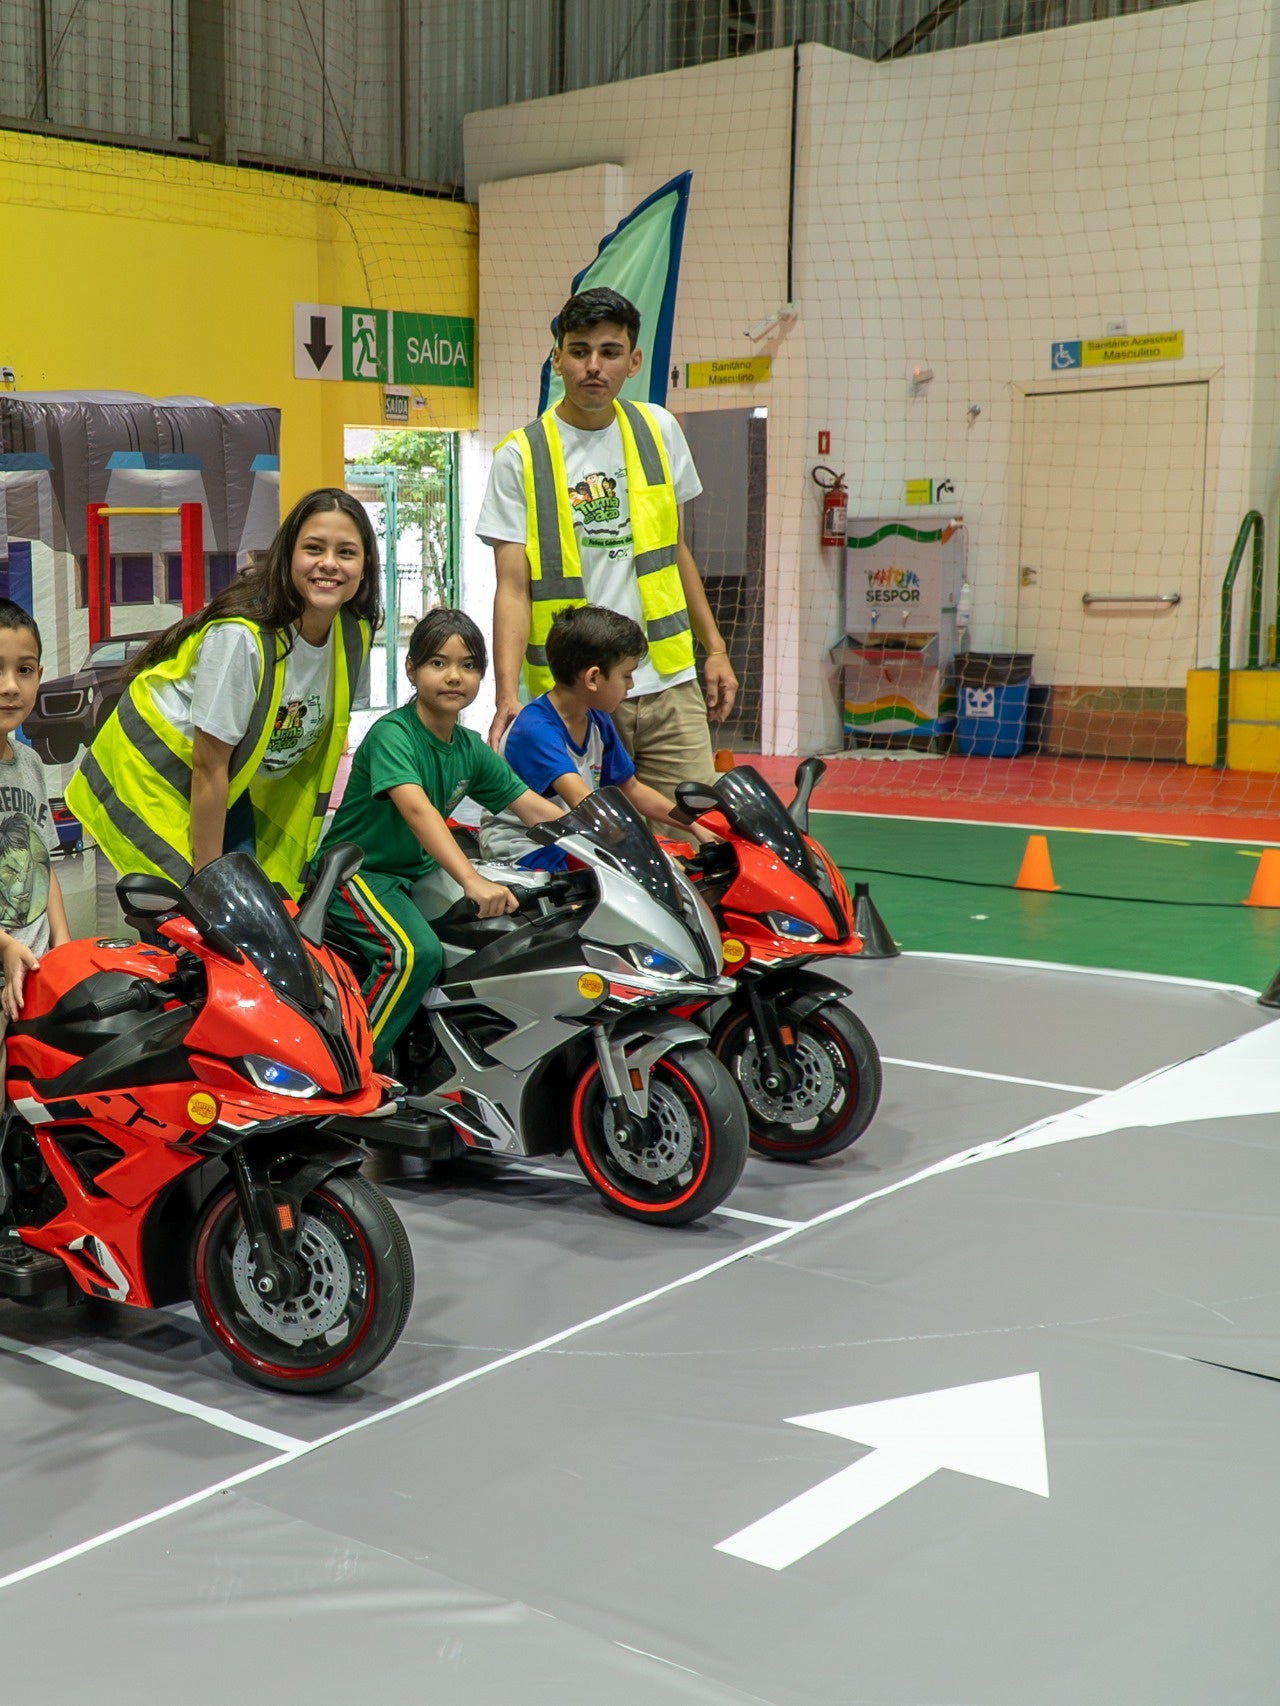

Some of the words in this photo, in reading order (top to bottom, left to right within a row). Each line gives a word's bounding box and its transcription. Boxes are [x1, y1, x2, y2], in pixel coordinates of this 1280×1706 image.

[406, 333, 467, 367] SAÍDA
[1104, 348, 1160, 360] Masculino
[711, 361, 752, 372] Sanitário
[708, 373, 754, 385] Masculino
[385, 396, 408, 415] SAÍDA
[572, 496, 620, 516] Turma
[866, 590, 920, 602] SESPOR
